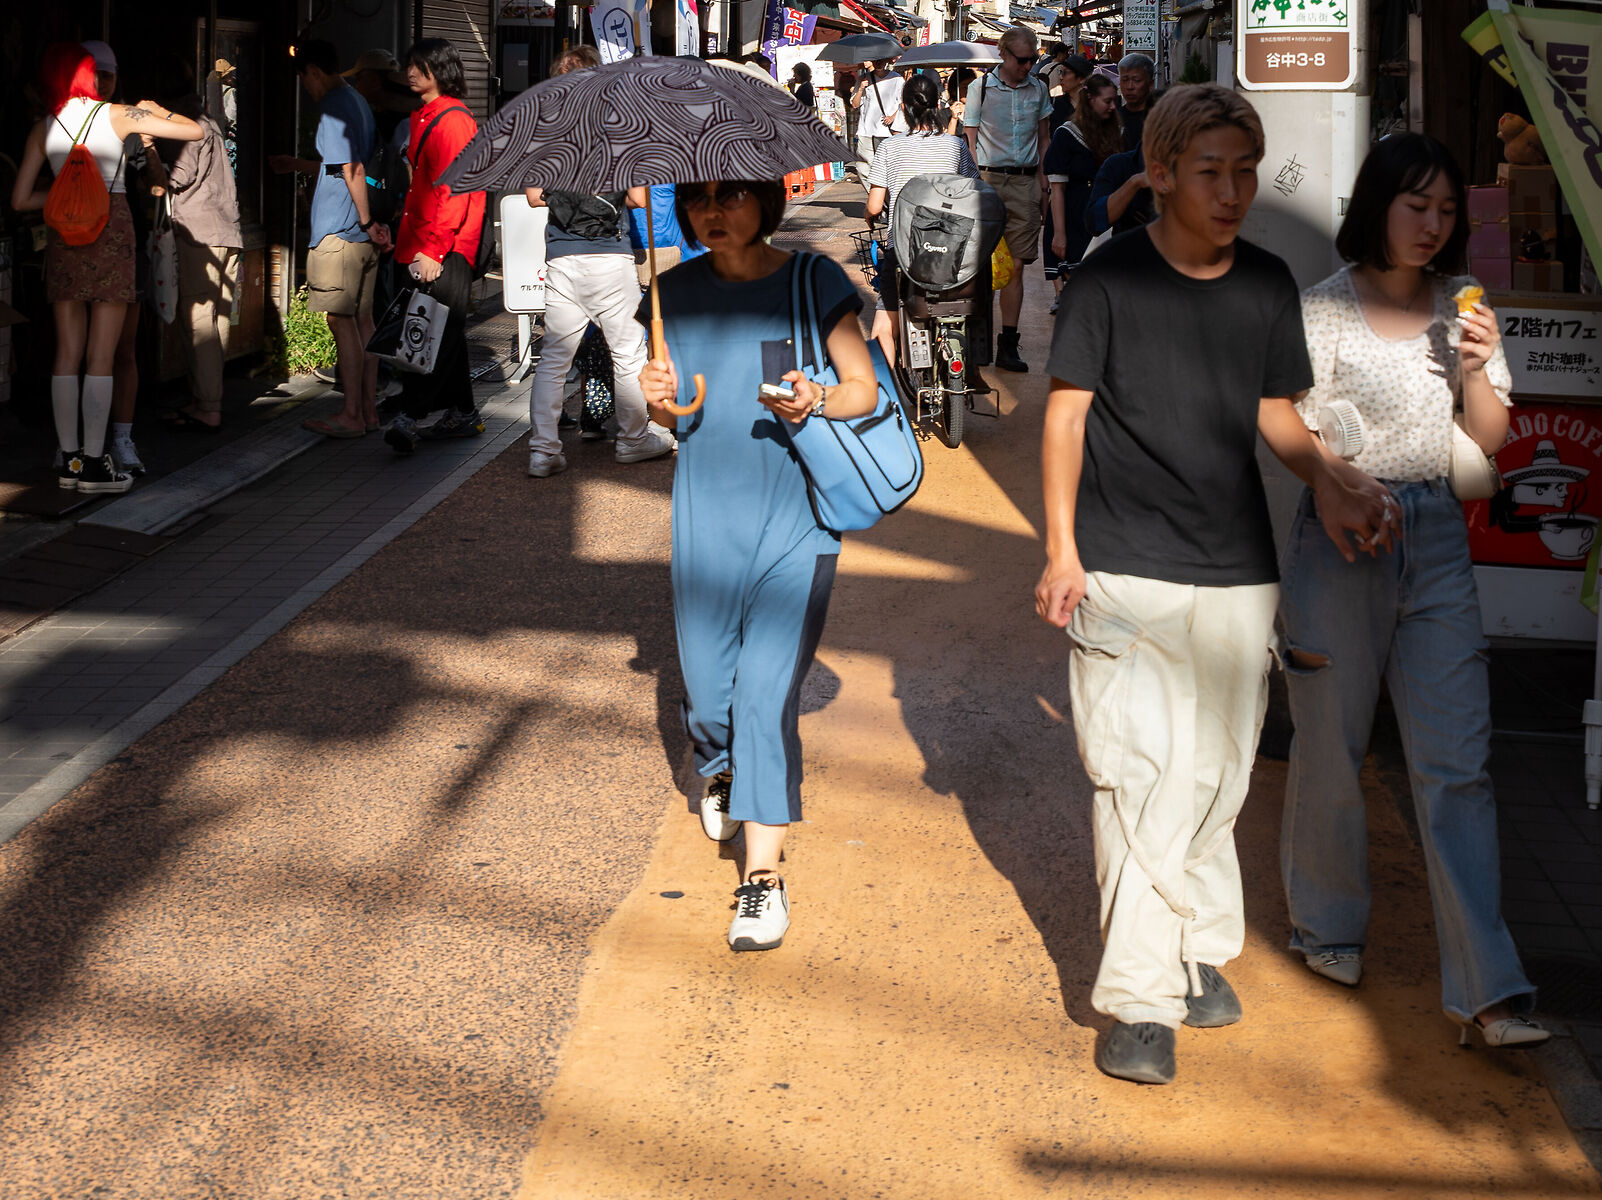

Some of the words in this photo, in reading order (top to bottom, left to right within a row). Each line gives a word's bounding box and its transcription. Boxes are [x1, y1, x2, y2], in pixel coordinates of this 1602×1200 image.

[1266, 52, 1326, 68] 谷中3-8
[1504, 317, 1598, 341] 2階カフェ
[1527, 350, 1587, 366] ミカド珈琲
[1552, 413, 1602, 458] COF
